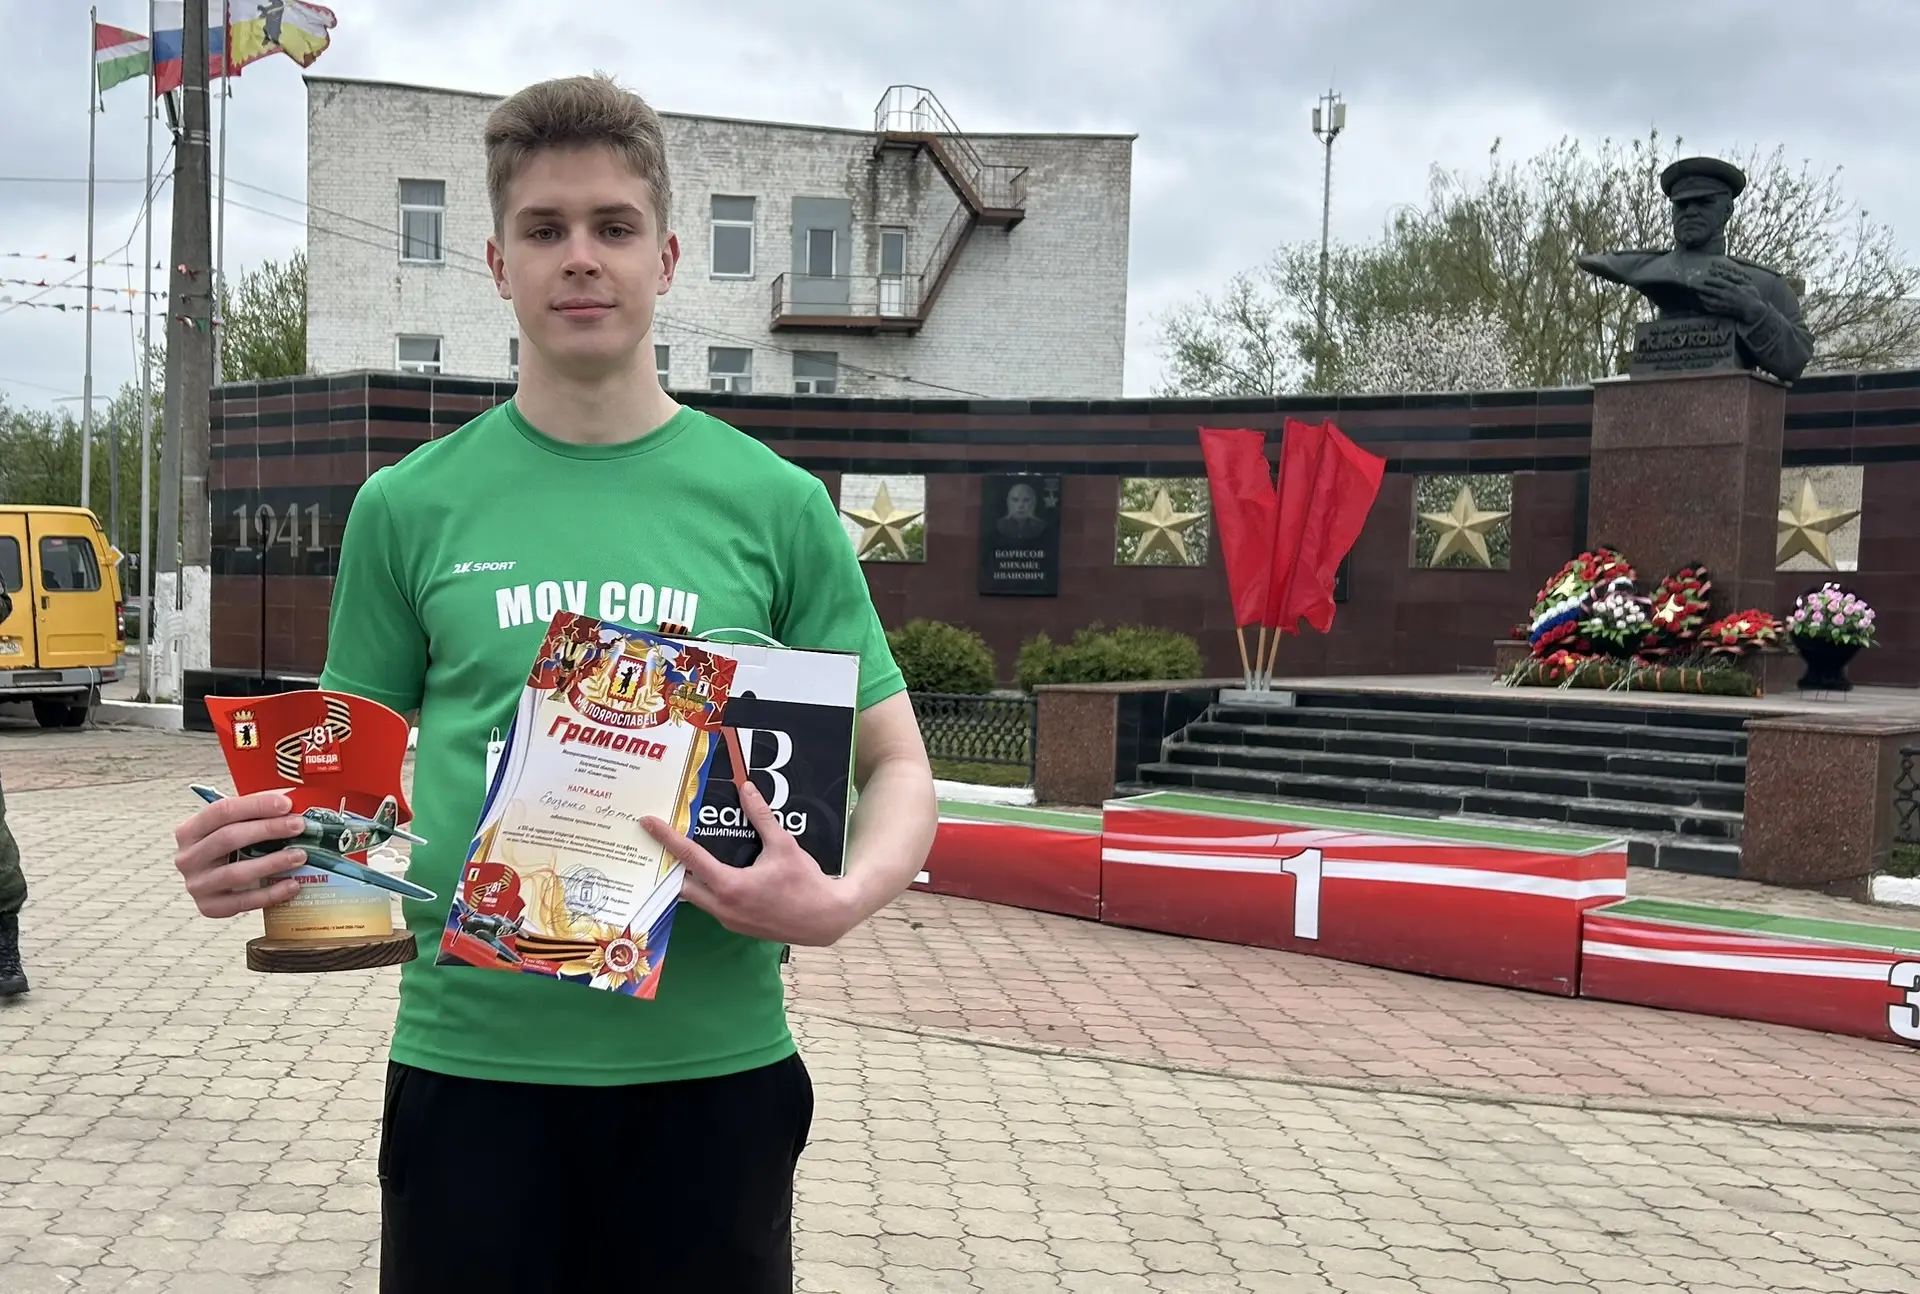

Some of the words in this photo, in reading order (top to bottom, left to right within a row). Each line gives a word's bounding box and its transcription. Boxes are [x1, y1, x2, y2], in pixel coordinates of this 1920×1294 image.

[233, 503, 324, 559] 1941
[472, 561, 517, 572] SPORT
[995, 549, 1045, 559] БОРИСОВ
[495, 581, 588, 629] МОУ
[599, 583, 699, 633] СОШ
[574, 694, 658, 727] МАЛОЯРОСЛАВЕЦ
[313, 725, 334, 745] 81
[547, 715, 668, 762] Грамота
[567, 784, 613, 799] НАГРАЖДАЕТ
[694, 826, 756, 839] одшипники
[1280, 847, 1322, 942] 1
